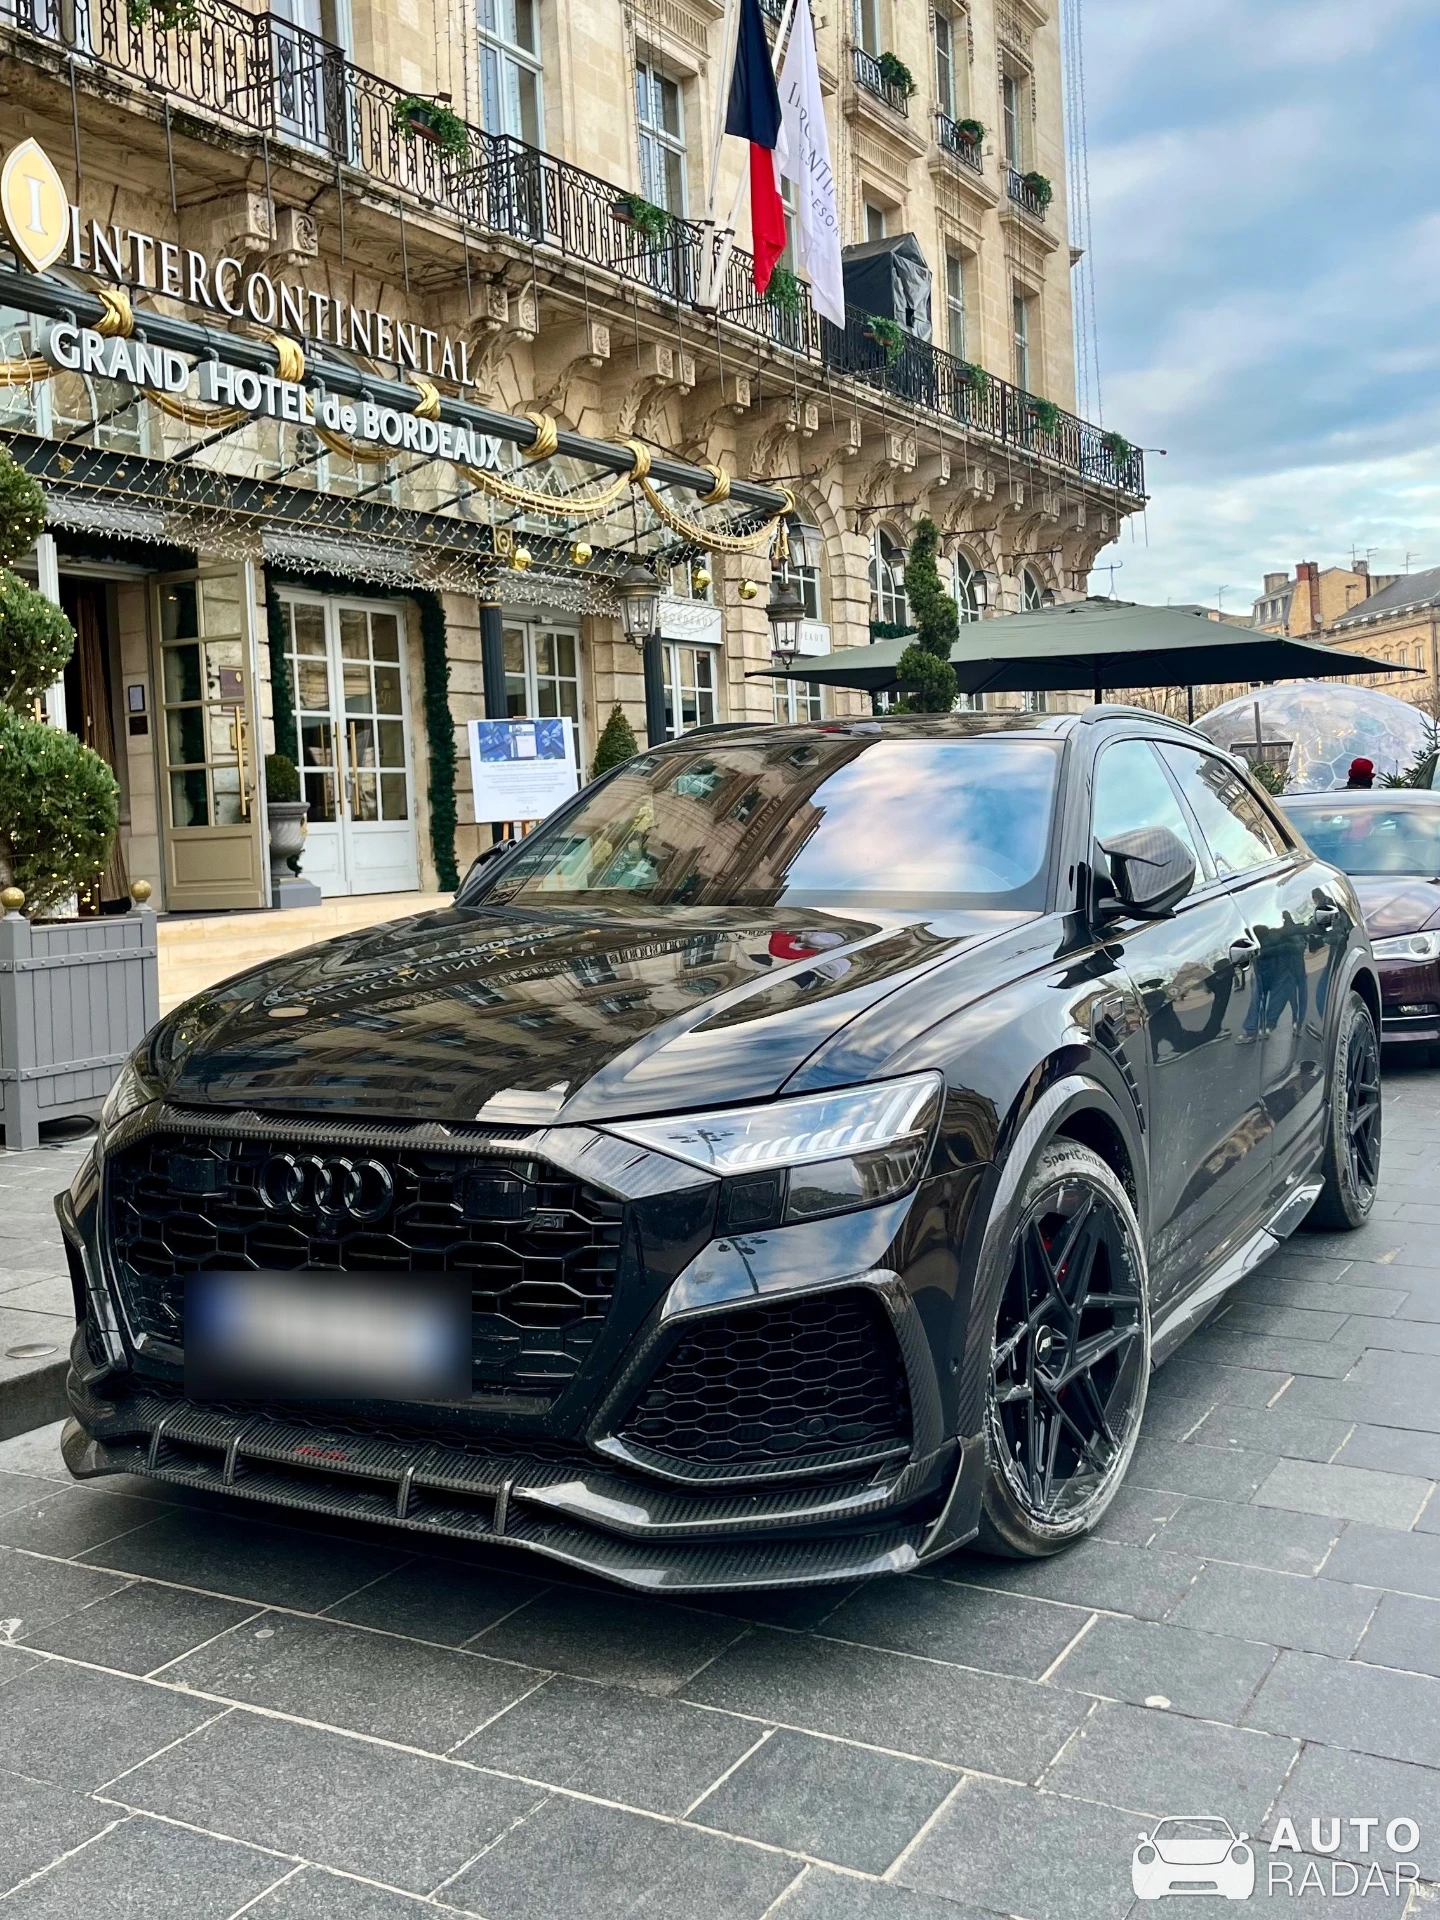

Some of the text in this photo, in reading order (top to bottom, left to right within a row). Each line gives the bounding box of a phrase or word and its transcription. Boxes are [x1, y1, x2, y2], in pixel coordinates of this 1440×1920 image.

[68, 204, 475, 386] INTERCONTINENTAL
[50, 323, 503, 472] GRAND HOTEL de BORDEAUX
